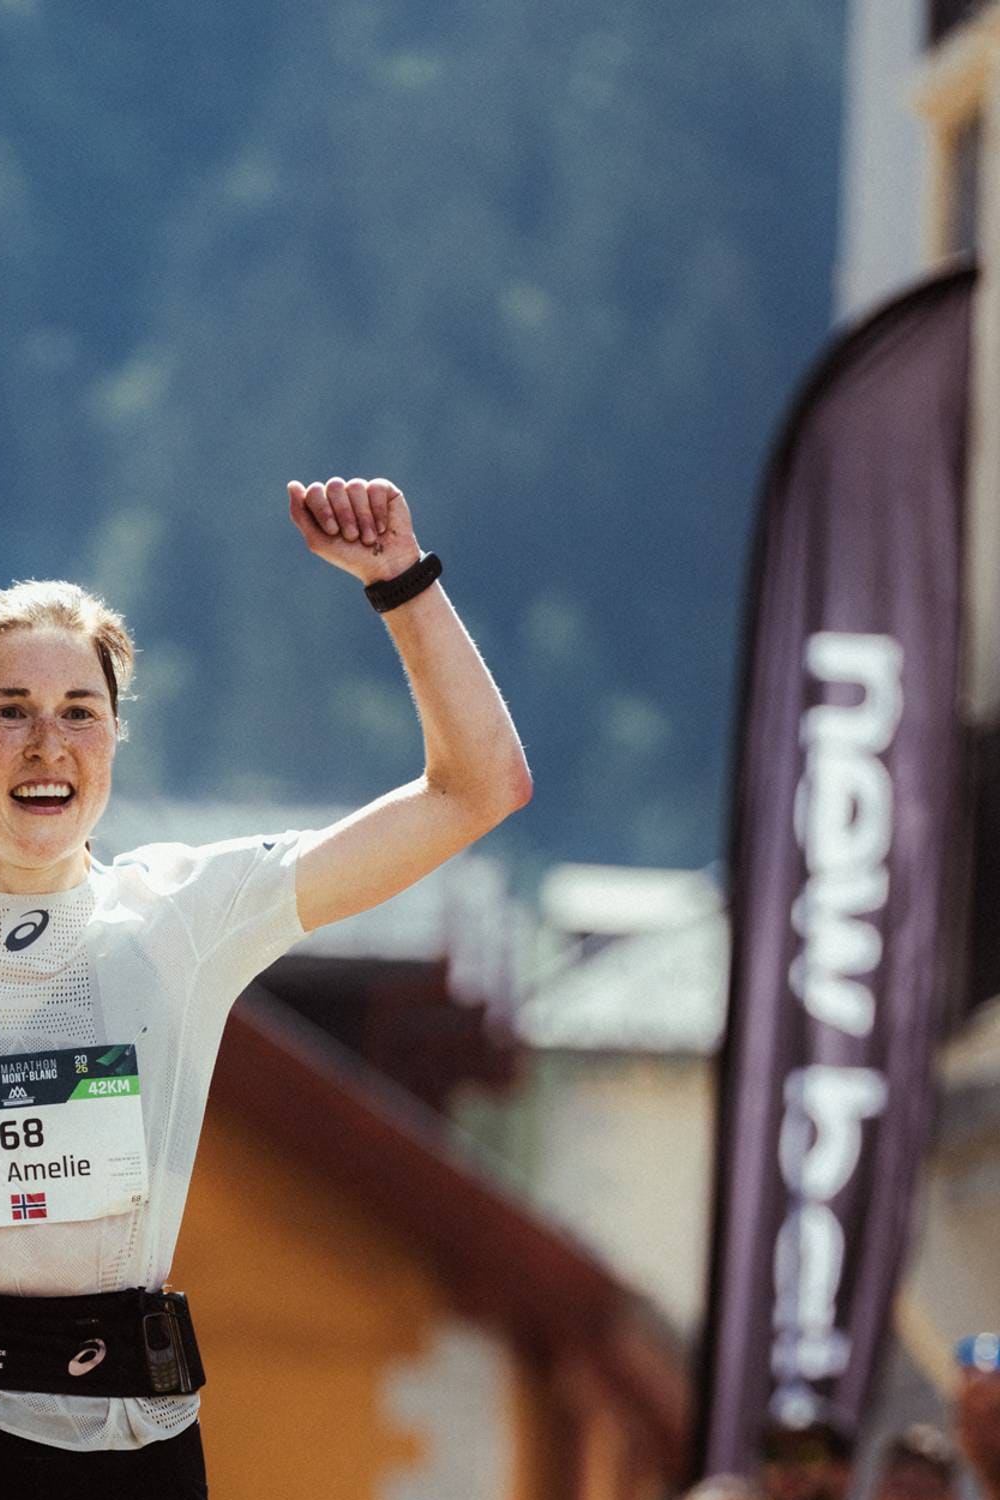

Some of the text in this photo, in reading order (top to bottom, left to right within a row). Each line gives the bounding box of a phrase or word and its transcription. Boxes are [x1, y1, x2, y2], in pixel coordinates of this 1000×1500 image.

[788, 632, 904, 1038] new
[0, 1059, 57, 1074] MARATHON
[74, 1054, 88, 1065] 20
[75, 1064, 89, 1074] 26
[88, 1079, 130, 1095] 42KM
[0, 1118, 44, 1150] 68
[8, 1154, 91, 1182] Amelie
